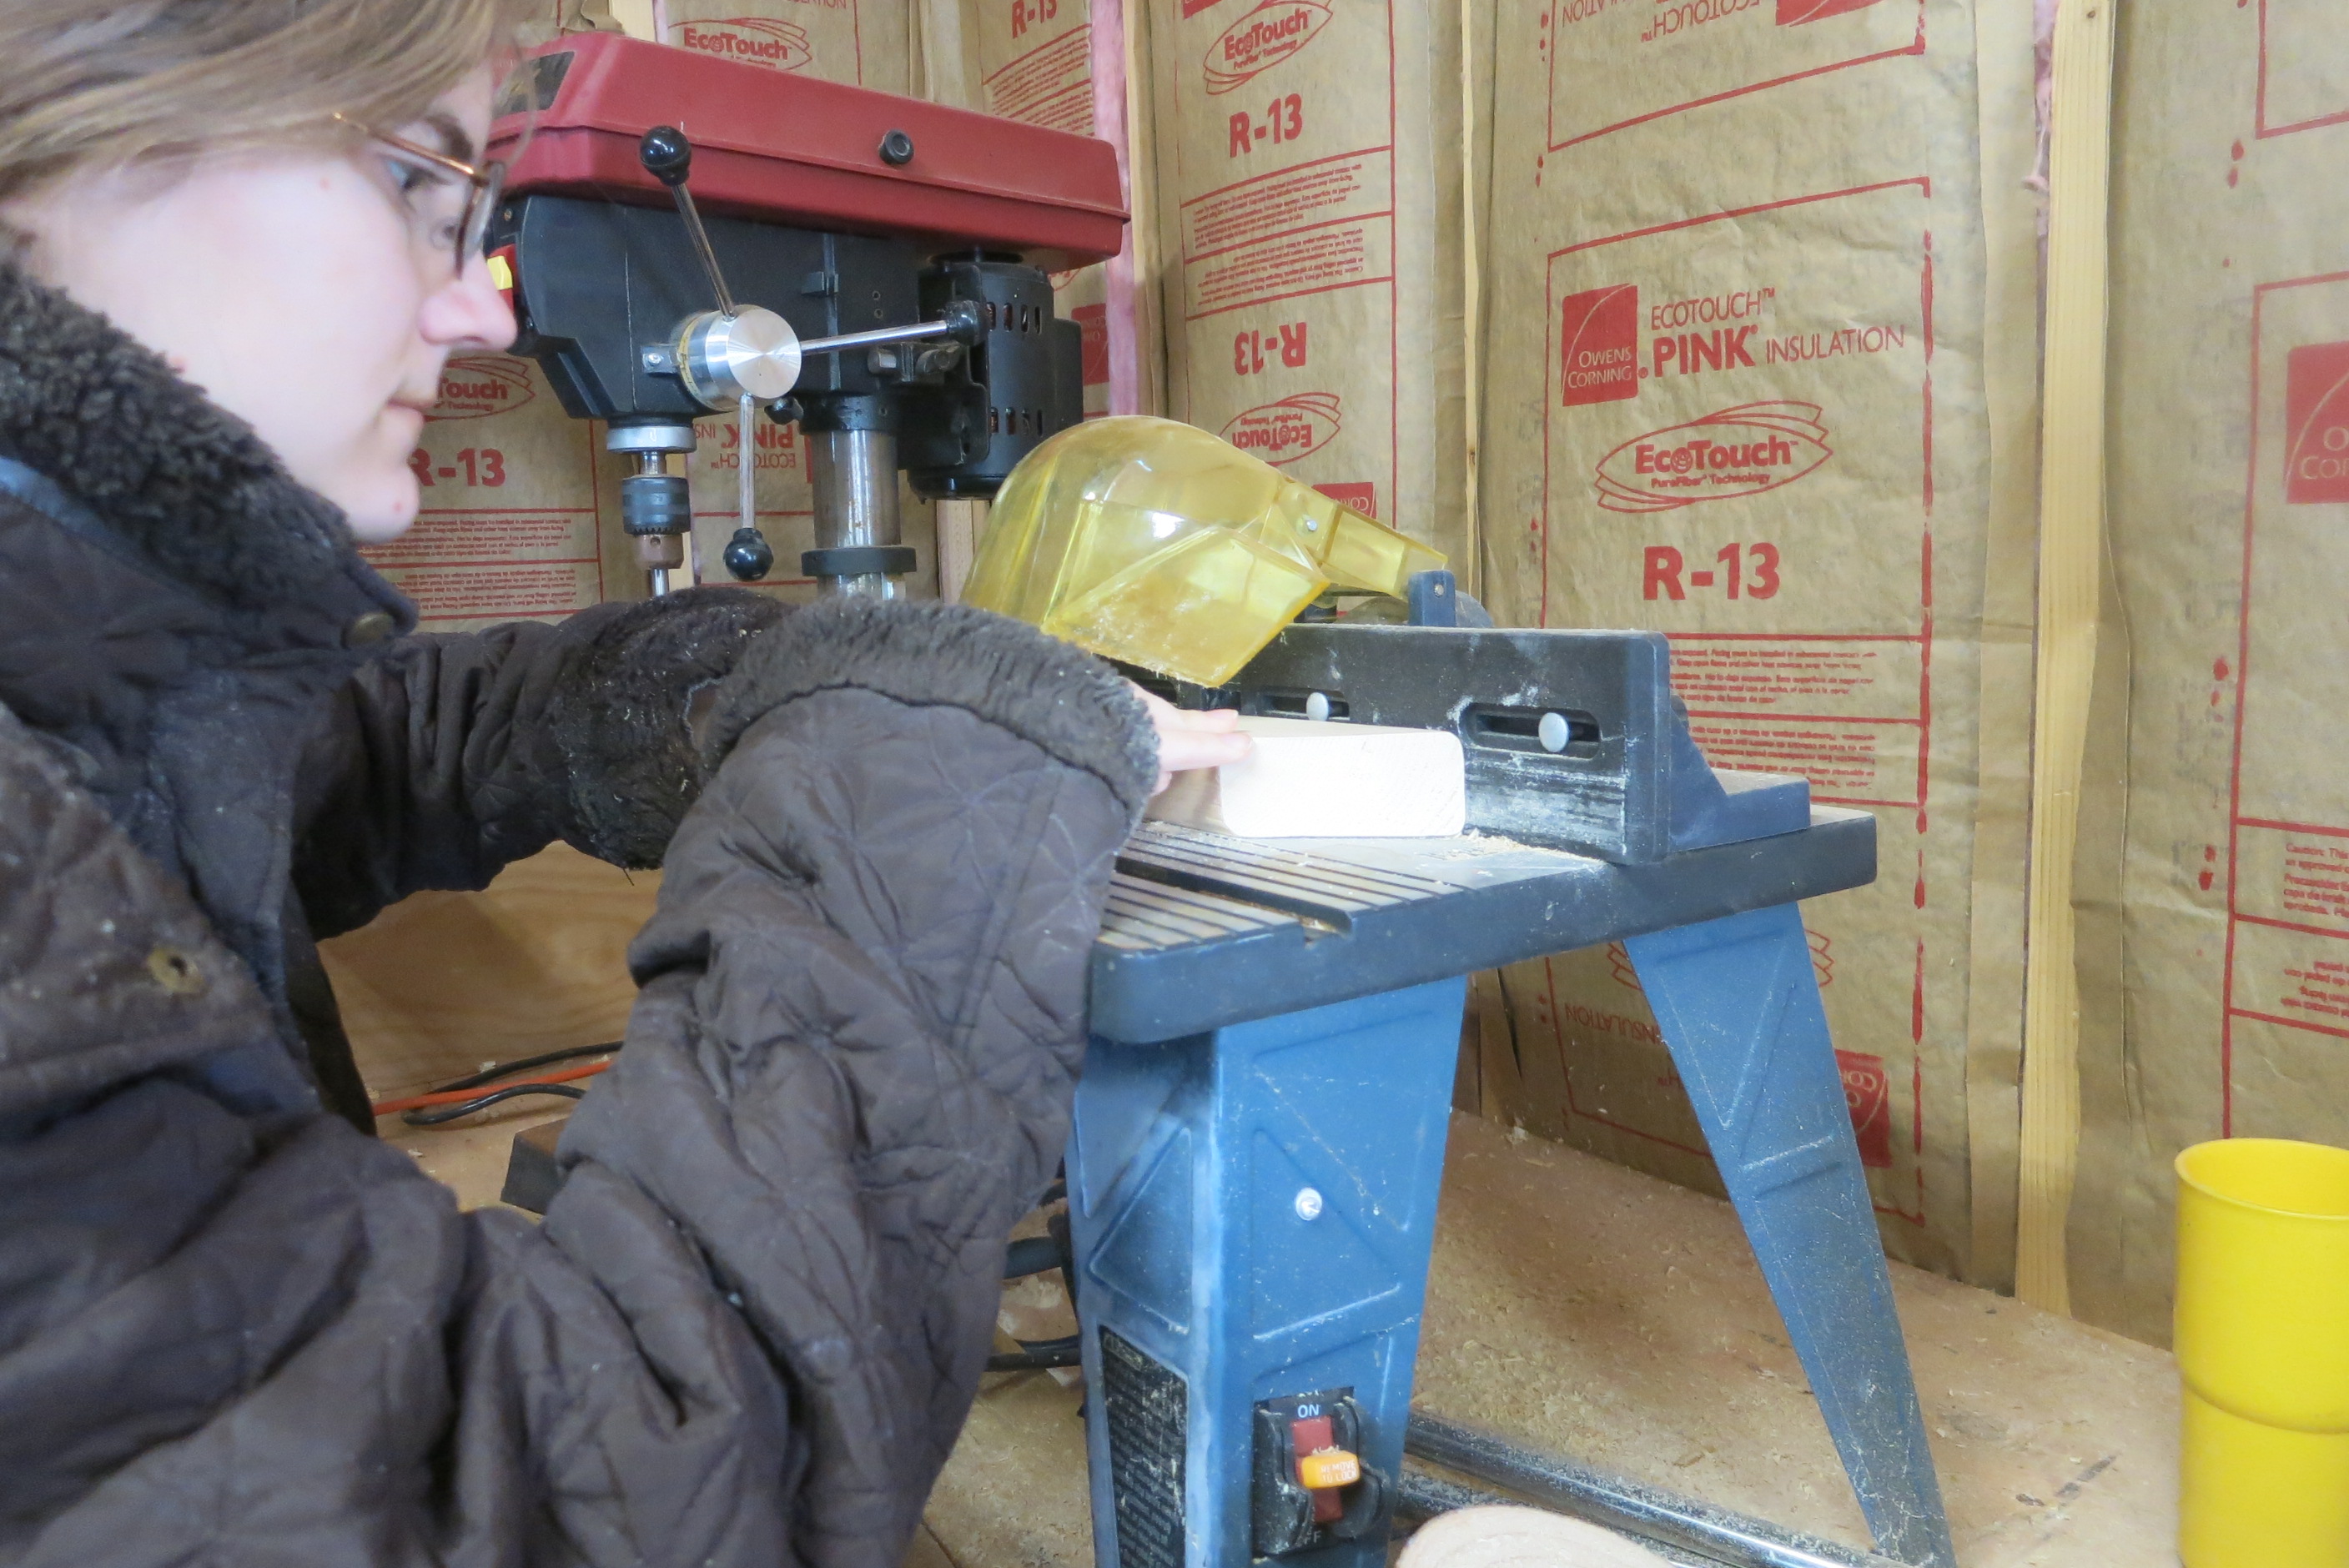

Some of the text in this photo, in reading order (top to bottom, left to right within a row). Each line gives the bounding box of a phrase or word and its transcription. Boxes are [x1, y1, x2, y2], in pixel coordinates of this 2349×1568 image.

[683, 28, 788, 60] EcoTouch
[1229, 93, 1303, 158] R-13
[1234, 322, 1307, 375] R-13
[1578, 346, 1632, 368] OWENS
[1766, 325, 1905, 364] INSULATION
[1568, 365, 1632, 389] CORNING
[1635, 435, 1791, 475] EcoTouch
[1643, 542, 1781, 601] R-13
[1297, 1404, 1320, 1418] ON
